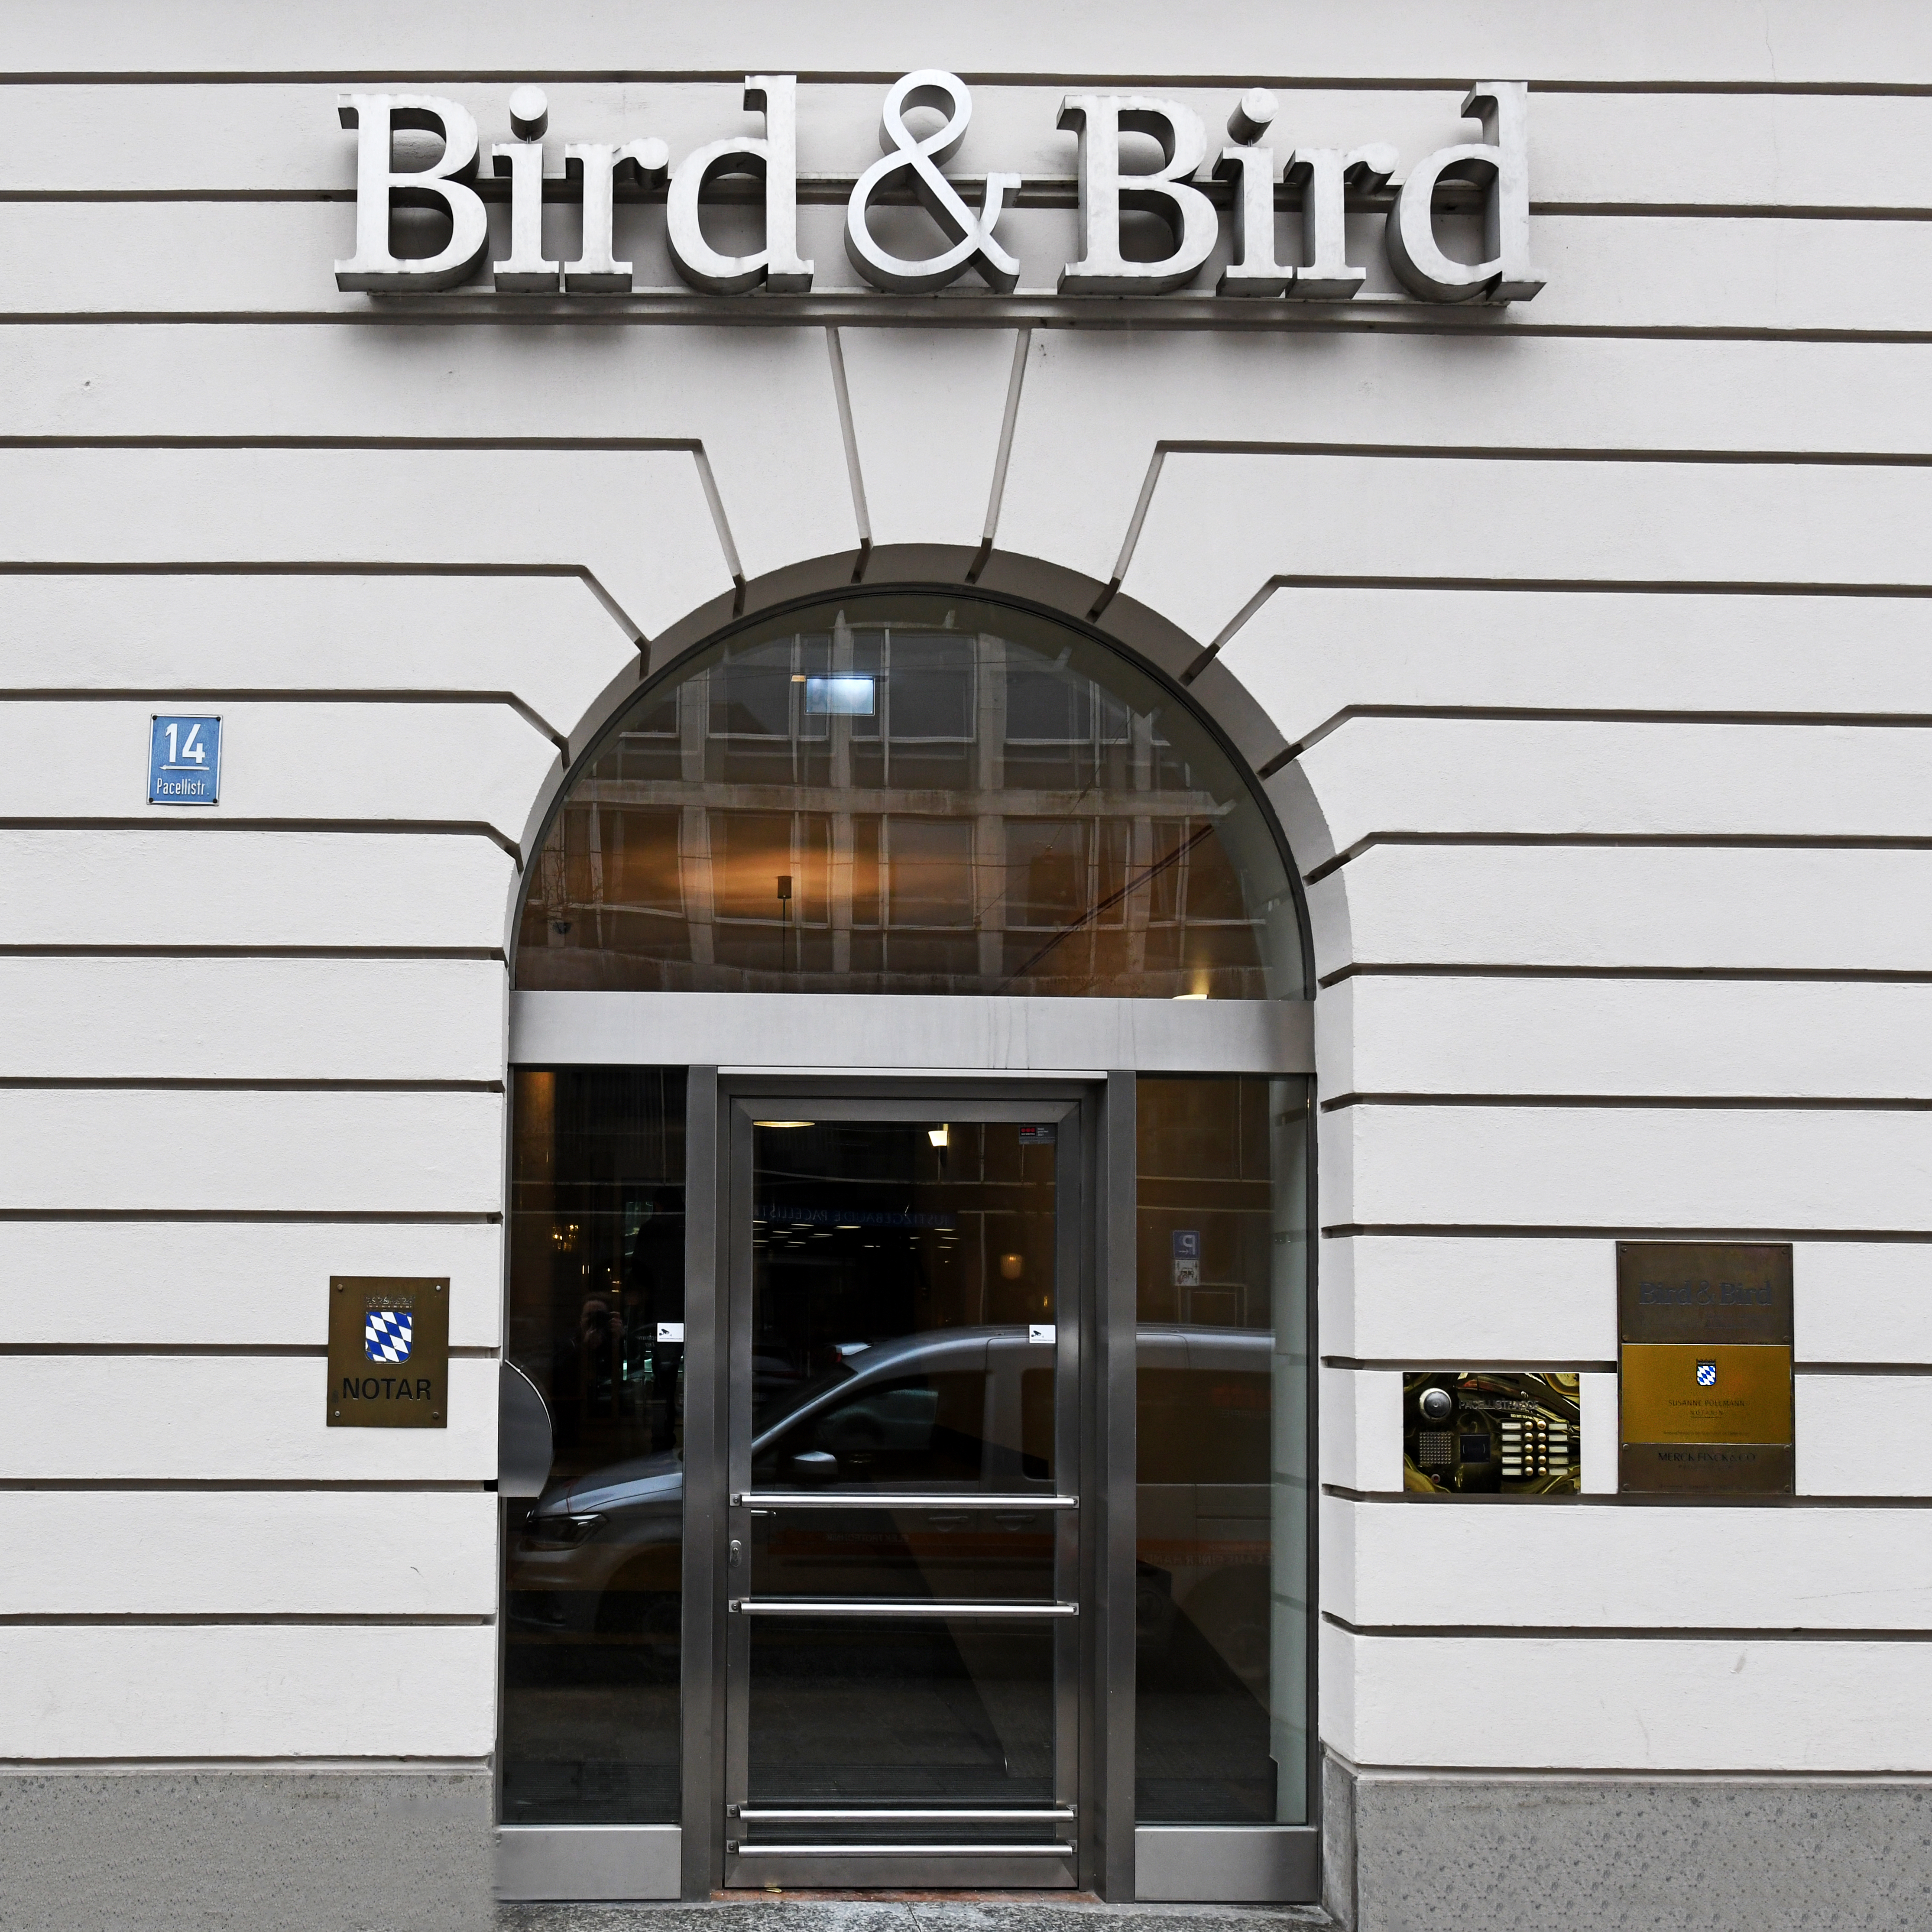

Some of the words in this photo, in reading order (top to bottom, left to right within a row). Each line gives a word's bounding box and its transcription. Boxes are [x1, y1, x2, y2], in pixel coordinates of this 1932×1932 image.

[334, 75, 814, 292] Bird
[844, 68, 1021, 293] &
[1057, 82, 1547, 300] Bird
[165, 723, 206, 764] 14
[156, 778, 210, 795] Pacellistr.
[1638, 1280, 1692, 1305] Bird
[1696, 1280, 1716, 1306] &
[1719, 1281, 1773, 1306] Bird
[342, 1378, 431, 1400] NOTAR
[1658, 1452, 1695, 1462] MERCK
